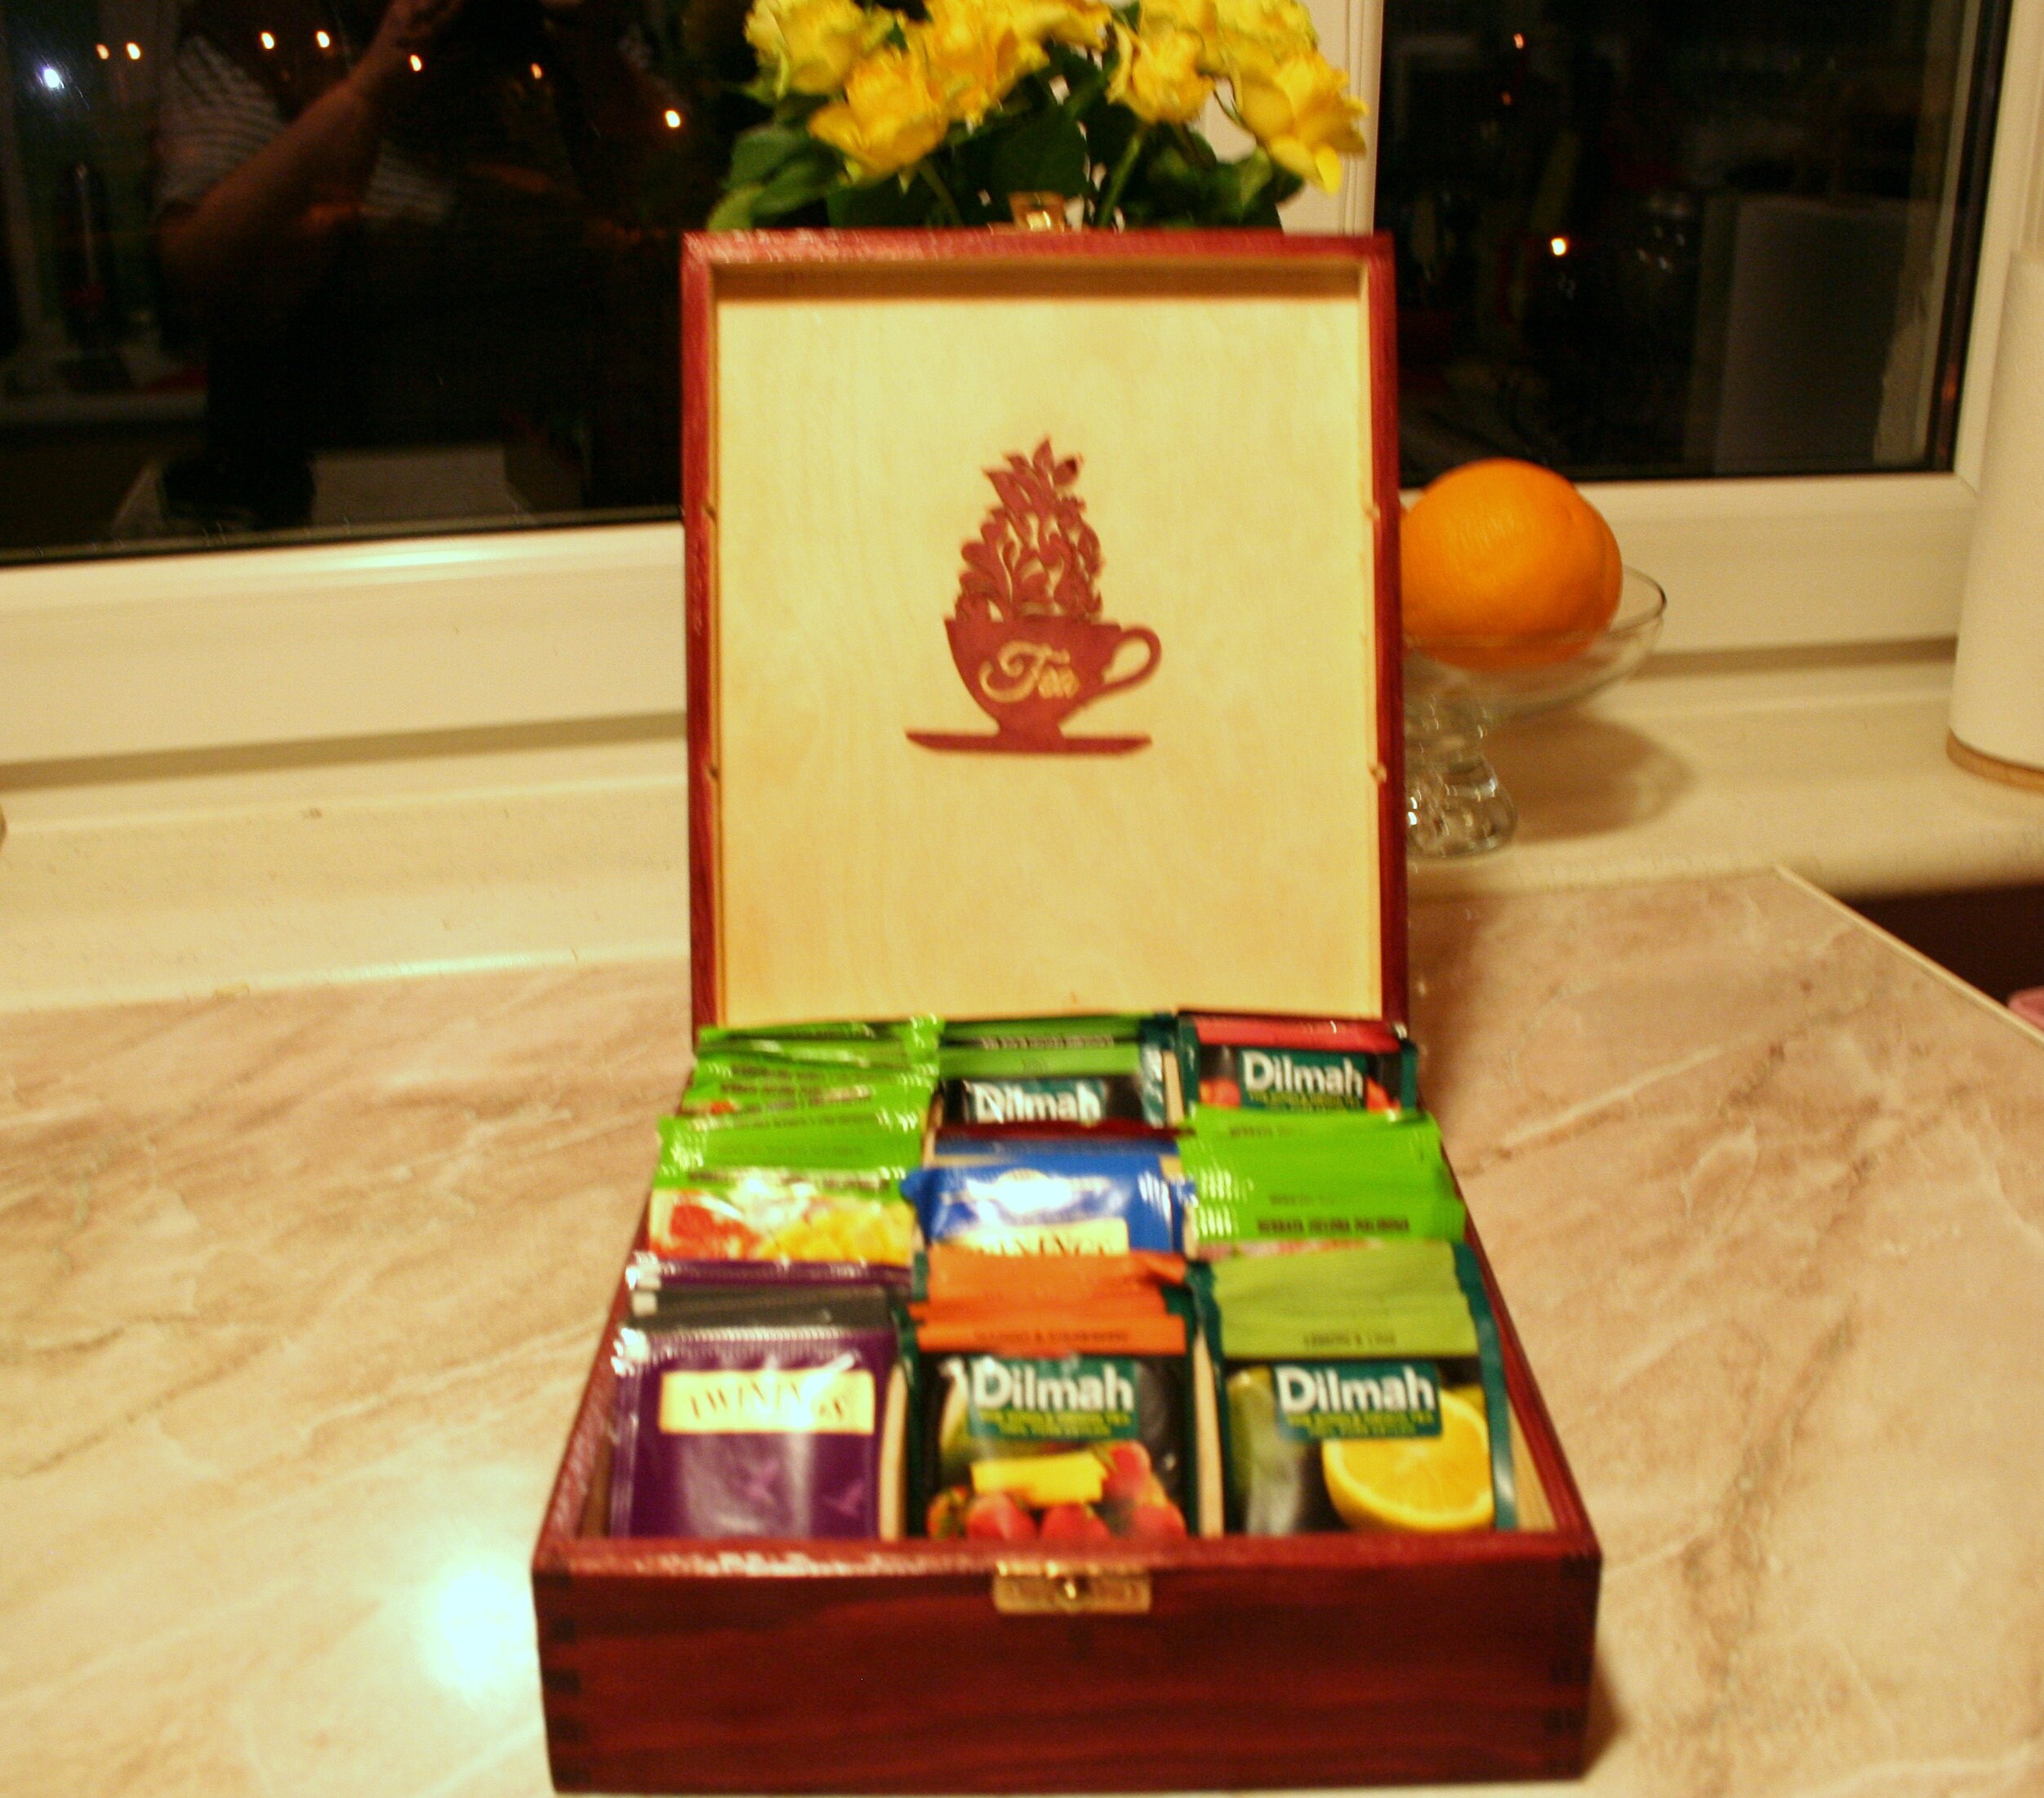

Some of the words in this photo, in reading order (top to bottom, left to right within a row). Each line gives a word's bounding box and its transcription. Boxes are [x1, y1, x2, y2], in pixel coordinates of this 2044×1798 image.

[979, 640, 1081, 701] Tea
[1240, 1050, 1364, 1099] Dilmah
[973, 1082, 1102, 1124] Dilmah
[973, 1355, 1134, 1412] Dilmah
[1275, 1364, 1436, 1413] Dilmah
